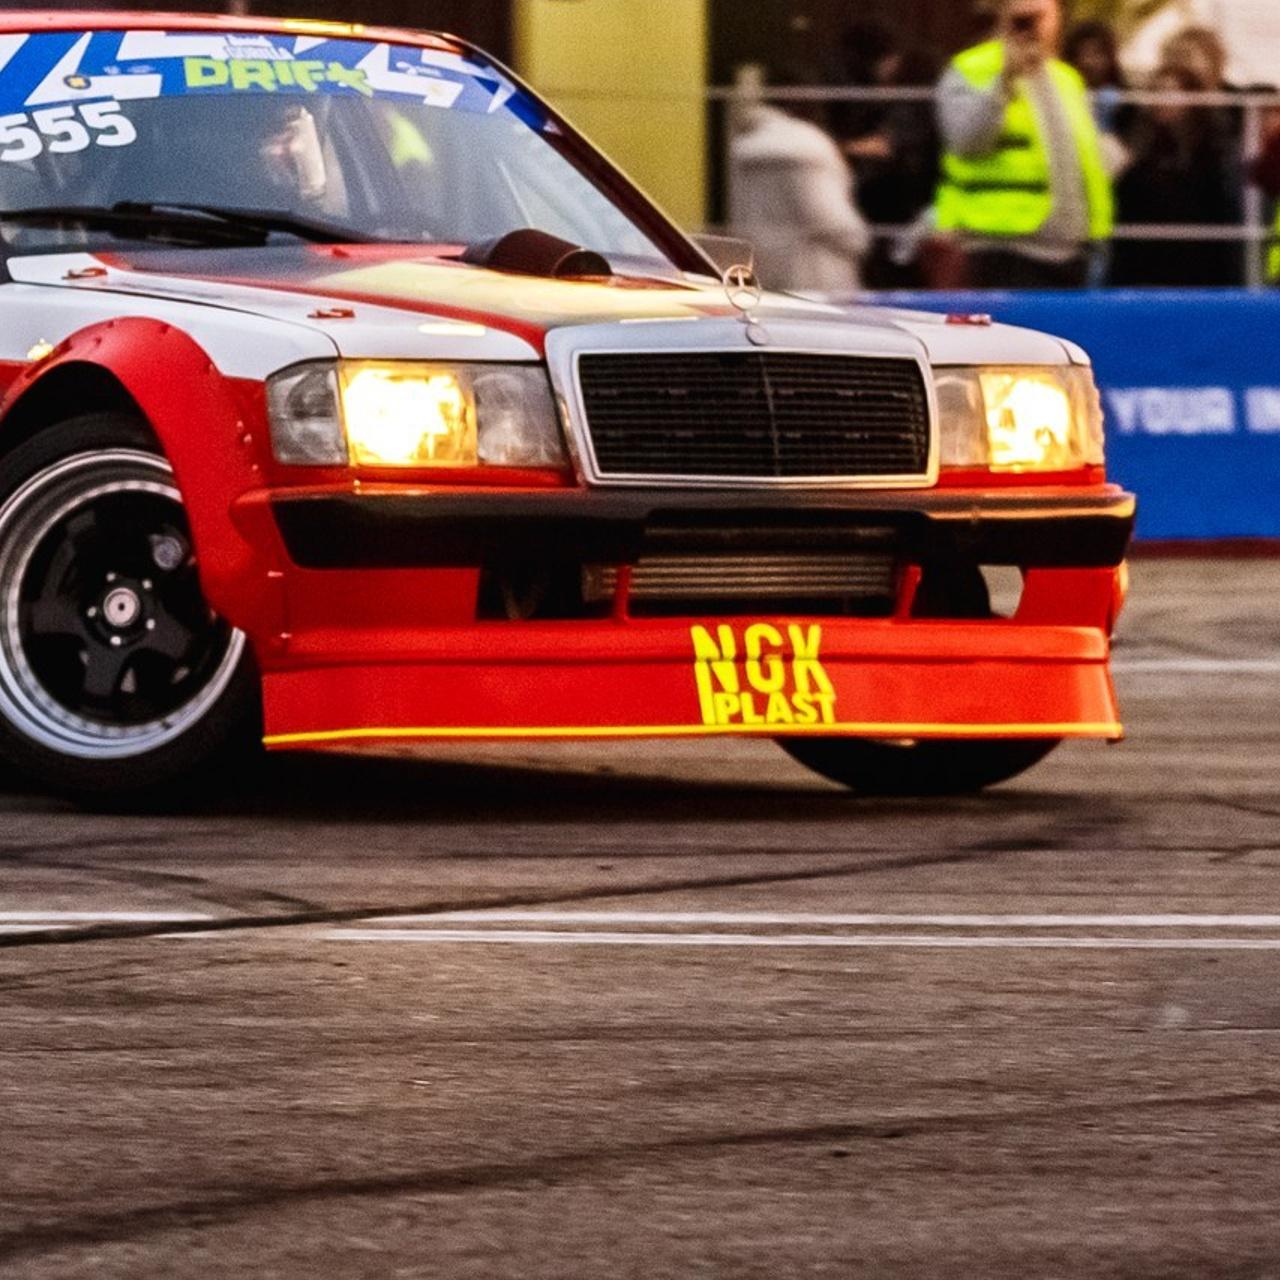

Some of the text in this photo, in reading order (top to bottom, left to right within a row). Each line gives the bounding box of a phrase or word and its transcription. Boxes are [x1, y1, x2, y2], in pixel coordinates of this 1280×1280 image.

[184, 57, 373, 97] DRIFT
[1106, 387, 1235, 434] YOUR
[691, 623, 835, 723] NGK
[714, 691, 836, 724] PLAST
